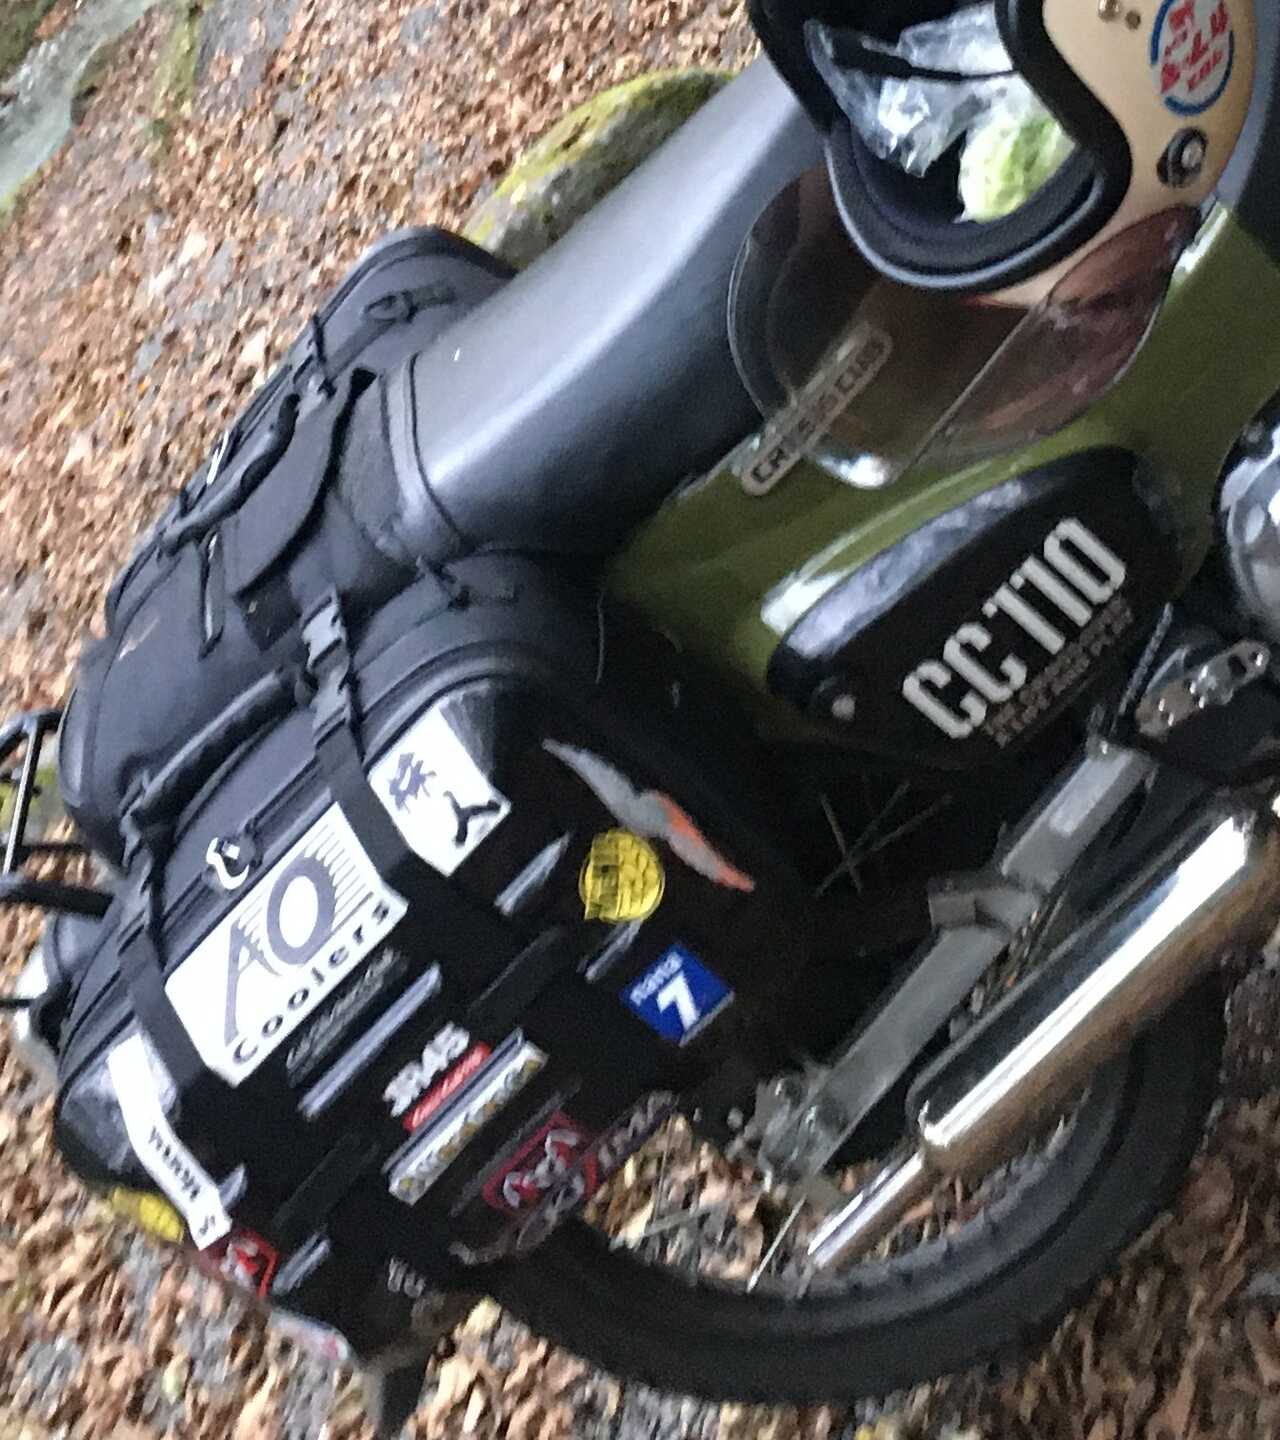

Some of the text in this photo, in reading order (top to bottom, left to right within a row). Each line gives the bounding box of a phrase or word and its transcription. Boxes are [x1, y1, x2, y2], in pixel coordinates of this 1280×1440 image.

[902, 517, 1128, 739] CC110
[223, 847, 338, 1048] AO
[232, 898, 390, 1065] Coolers
[656, 970, 699, 1032] 7
